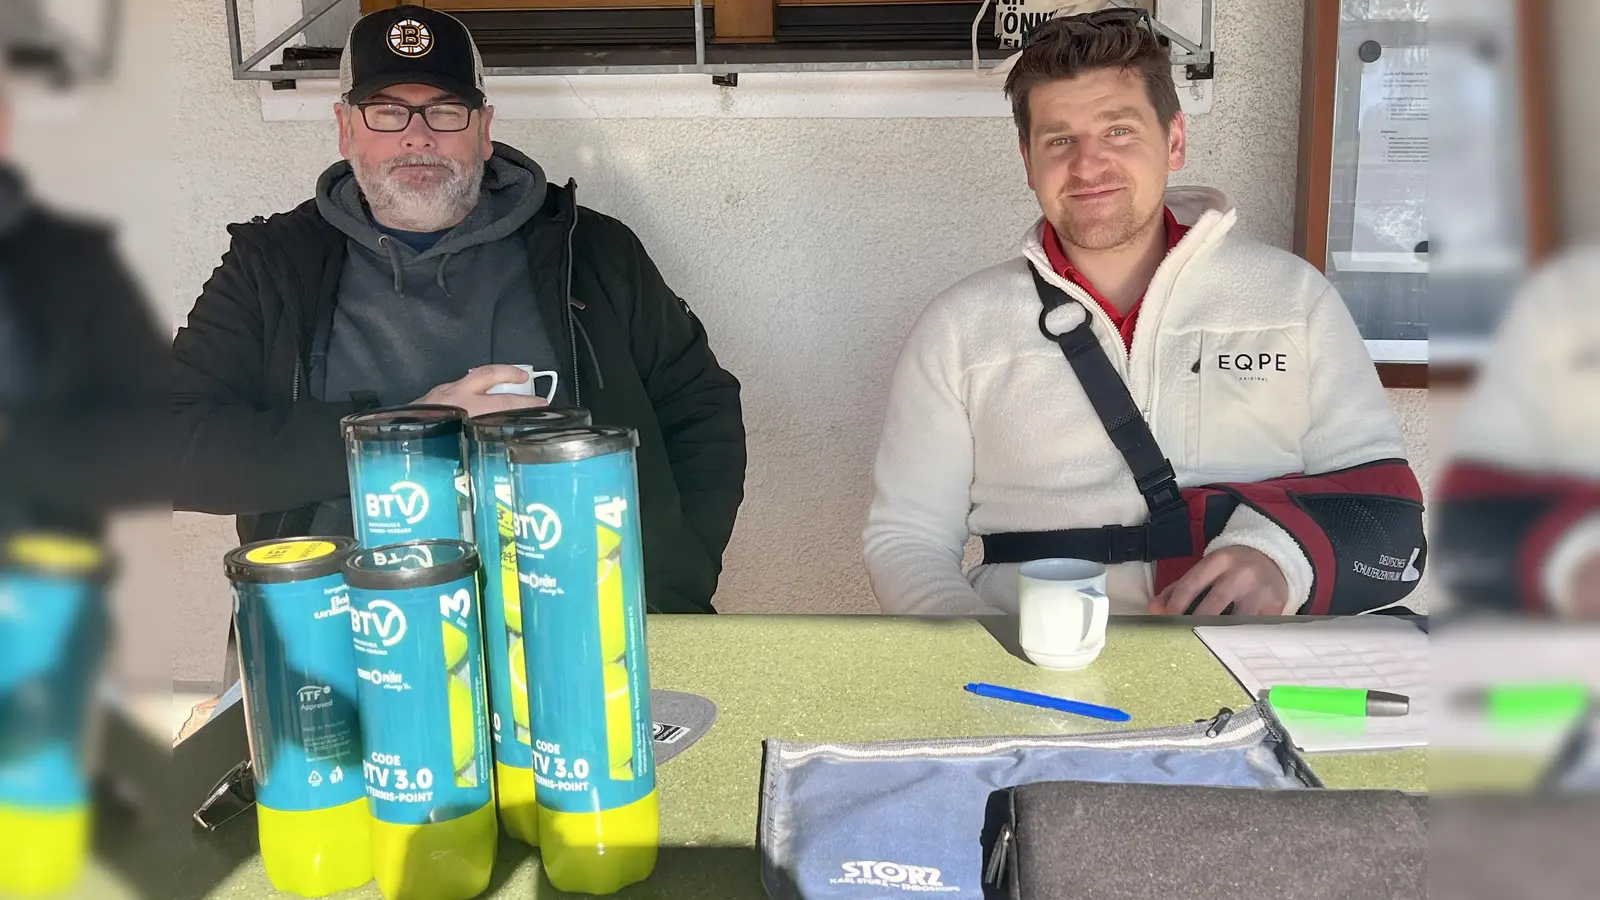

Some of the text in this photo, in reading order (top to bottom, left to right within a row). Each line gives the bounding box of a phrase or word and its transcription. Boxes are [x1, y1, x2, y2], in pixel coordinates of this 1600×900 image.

[999, 6, 1058, 34] ÖNN
[400, 25, 420, 47] B
[1218, 353, 1287, 372] EQPE
[365, 481, 430, 525] BTV
[513, 503, 562, 550] BTV
[439, 588, 471, 619] 3
[350, 599, 407, 648] BTV
[300, 689, 322, 702] ITF
[301, 700, 333, 711] Approved
[371, 751, 402, 767] CODE
[536, 739, 560, 755] CODE
[532, 749, 589, 779] TV 3.0
[394, 767, 433, 790] 3.0
[841, 860, 944, 887] STORZ
